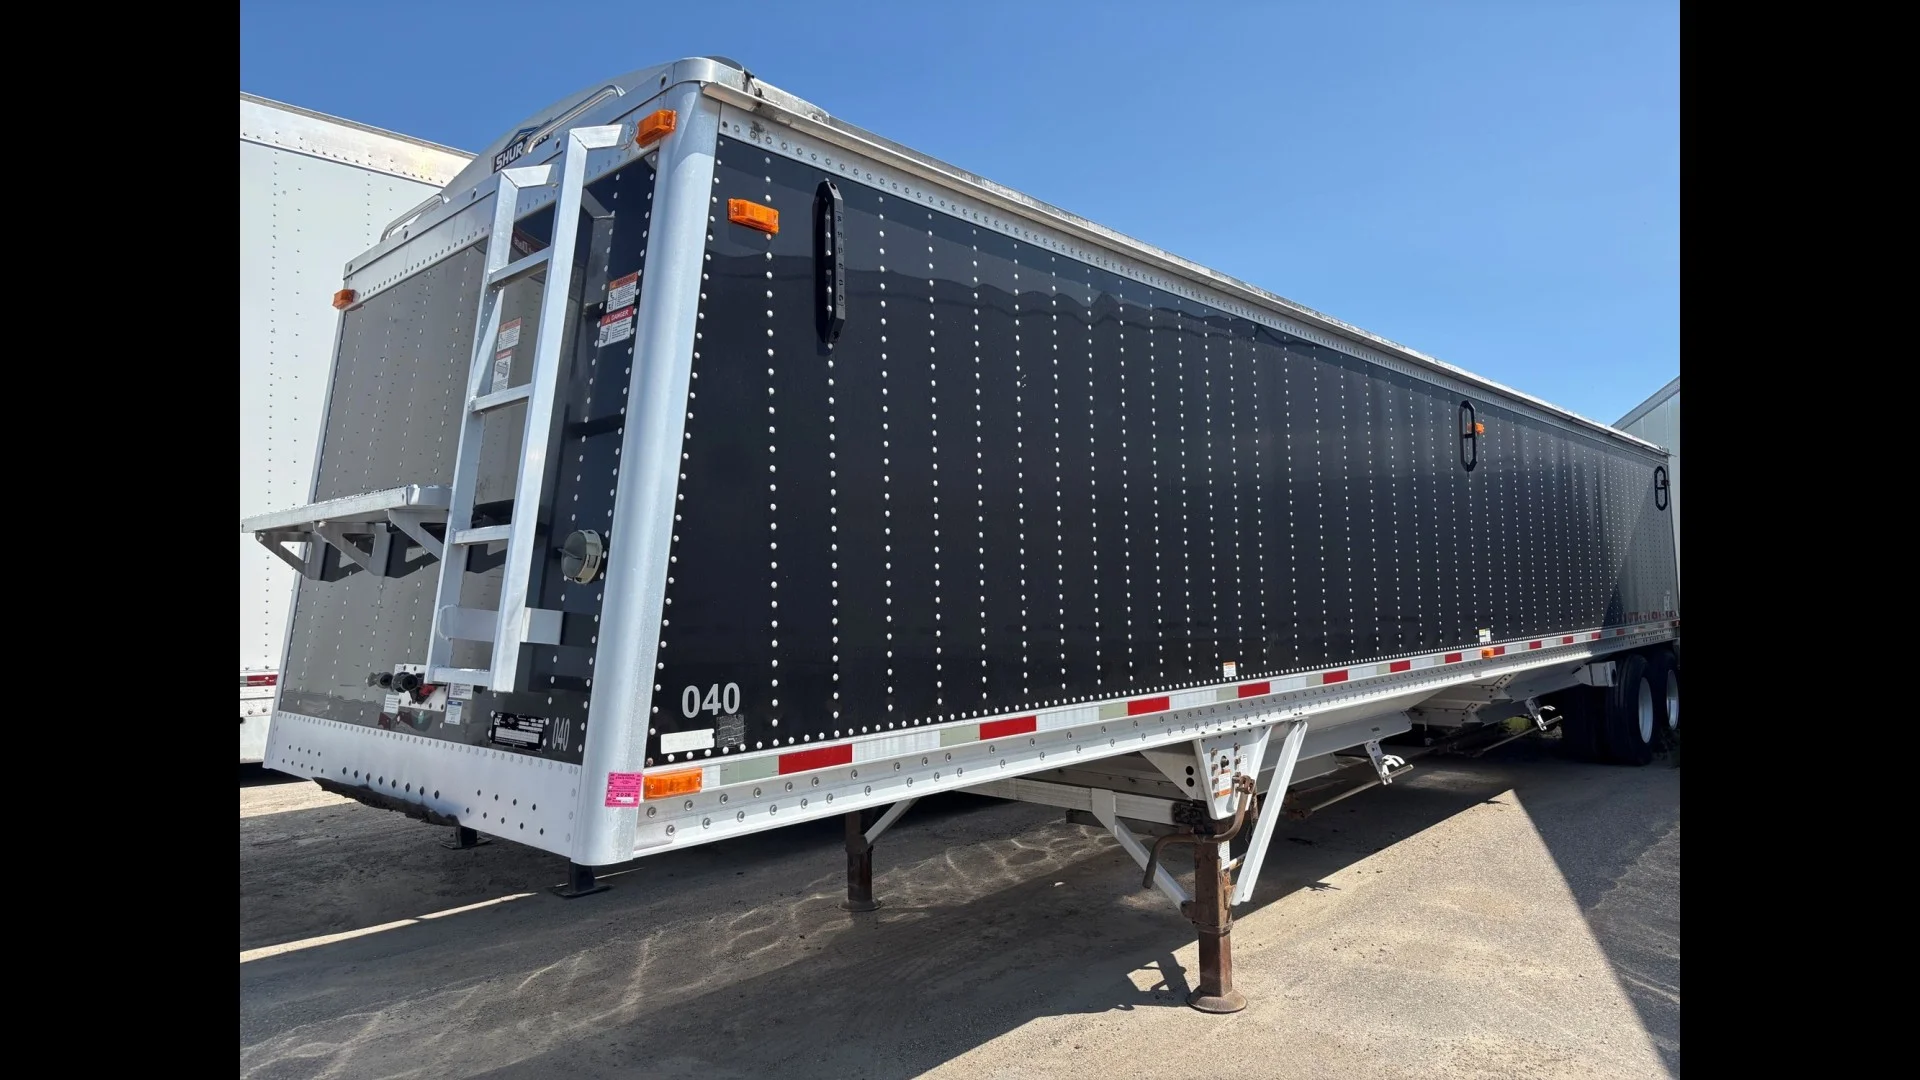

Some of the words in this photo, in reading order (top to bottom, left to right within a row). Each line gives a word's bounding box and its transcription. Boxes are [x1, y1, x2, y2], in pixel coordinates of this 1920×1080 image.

[611, 309, 629, 321] DANGER
[682, 682, 741, 719] 040
[552, 716, 571, 752] 040
